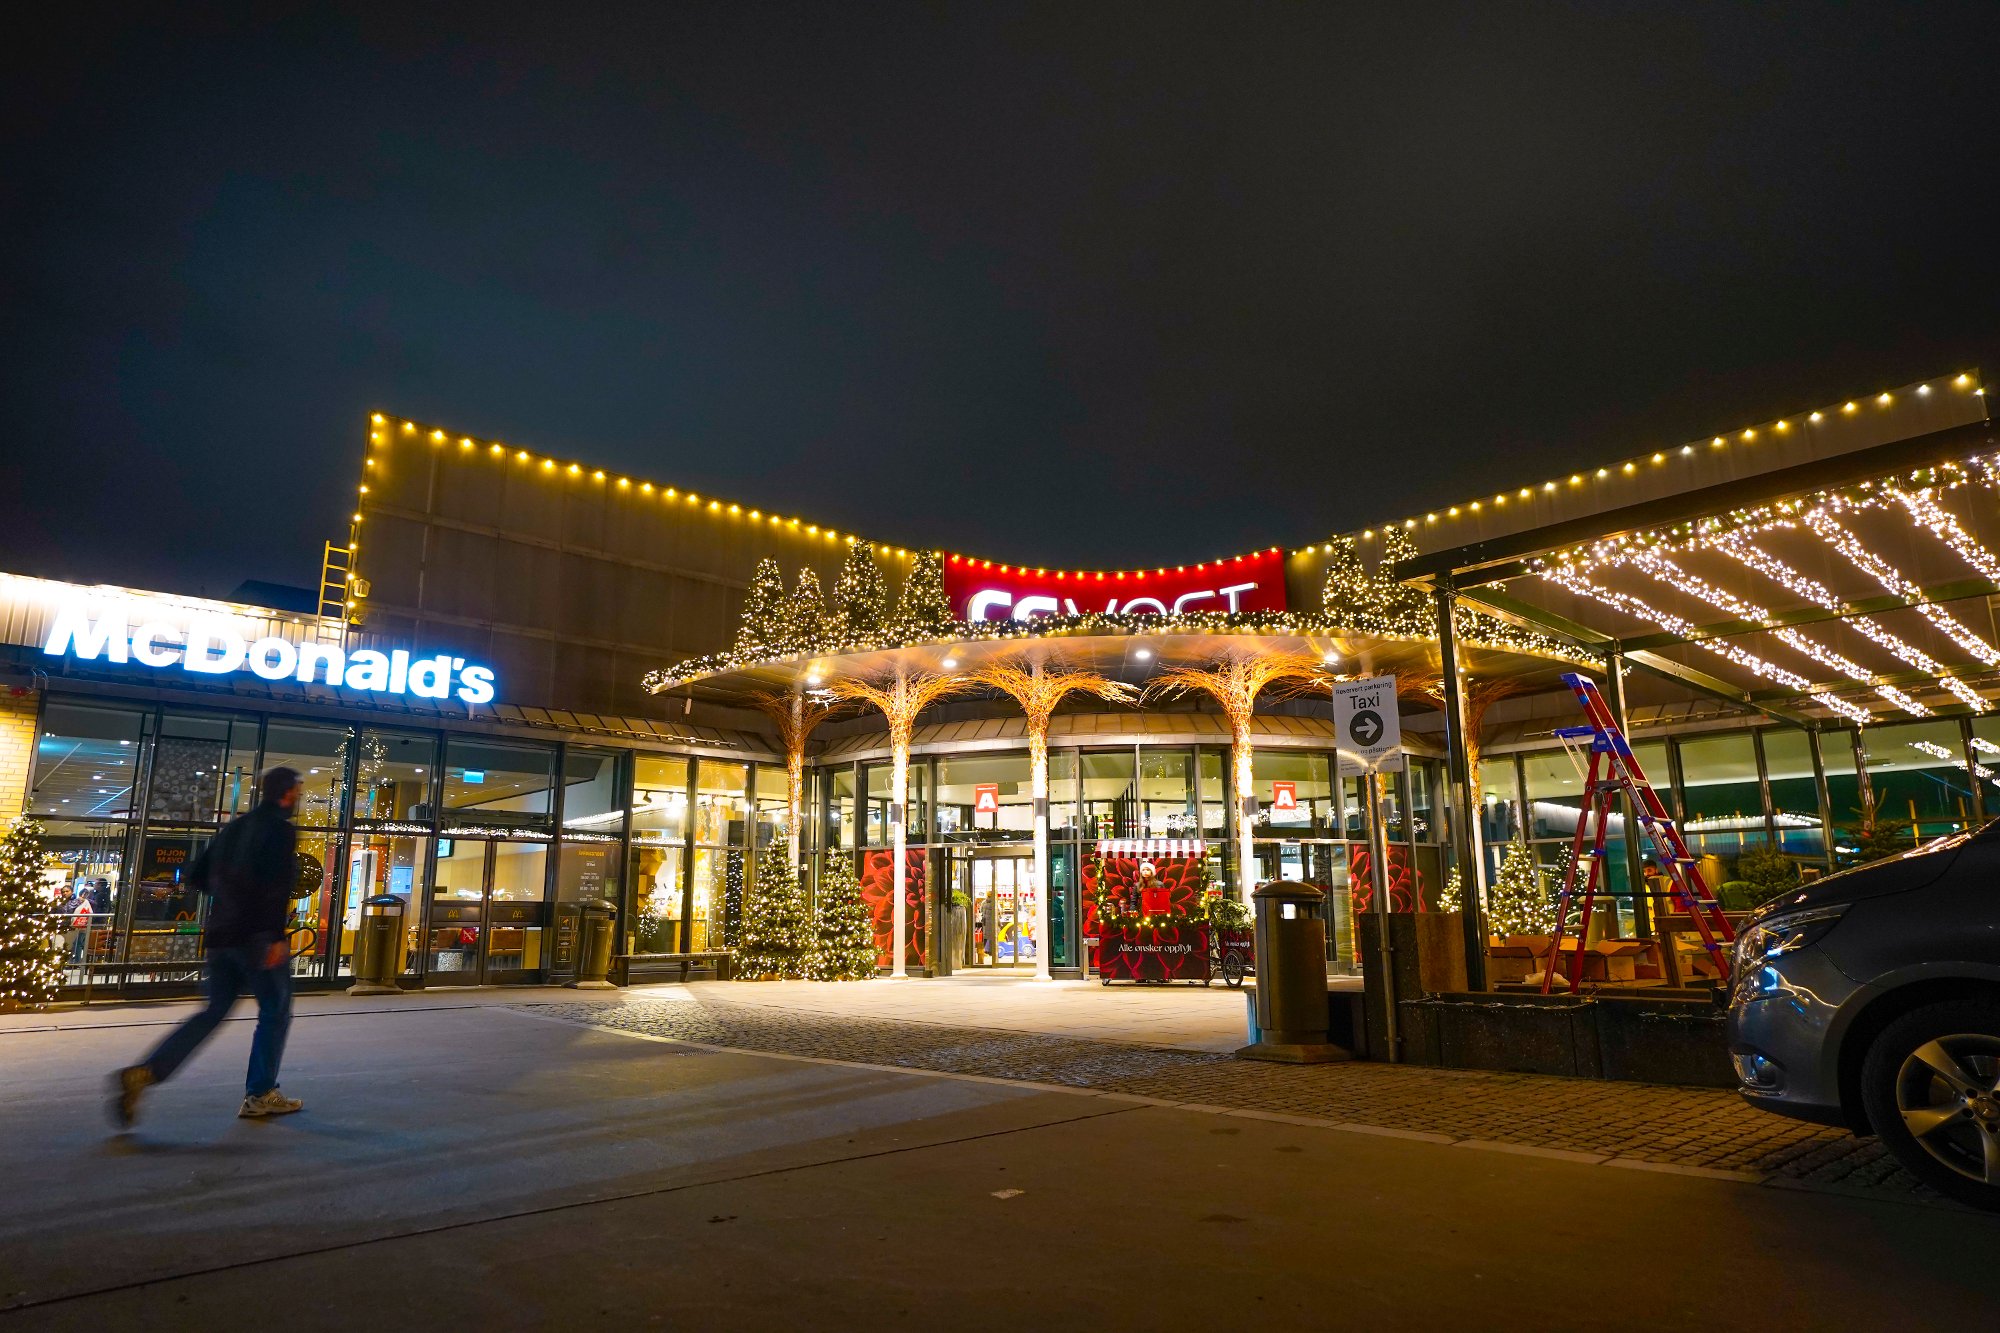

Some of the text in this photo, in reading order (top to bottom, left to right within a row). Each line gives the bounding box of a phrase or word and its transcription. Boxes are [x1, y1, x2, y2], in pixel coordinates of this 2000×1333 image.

[43, 599, 495, 704] McDonald's
[1335, 682, 1393, 695] Reservert parkering
[1349, 692, 1380, 710] Taxi
[156, 849, 187, 857] DIJON
[157, 856, 184, 864] MAYO
[1118, 943, 1133, 952] Alle
[1134, 943, 1163, 952] ønsker
